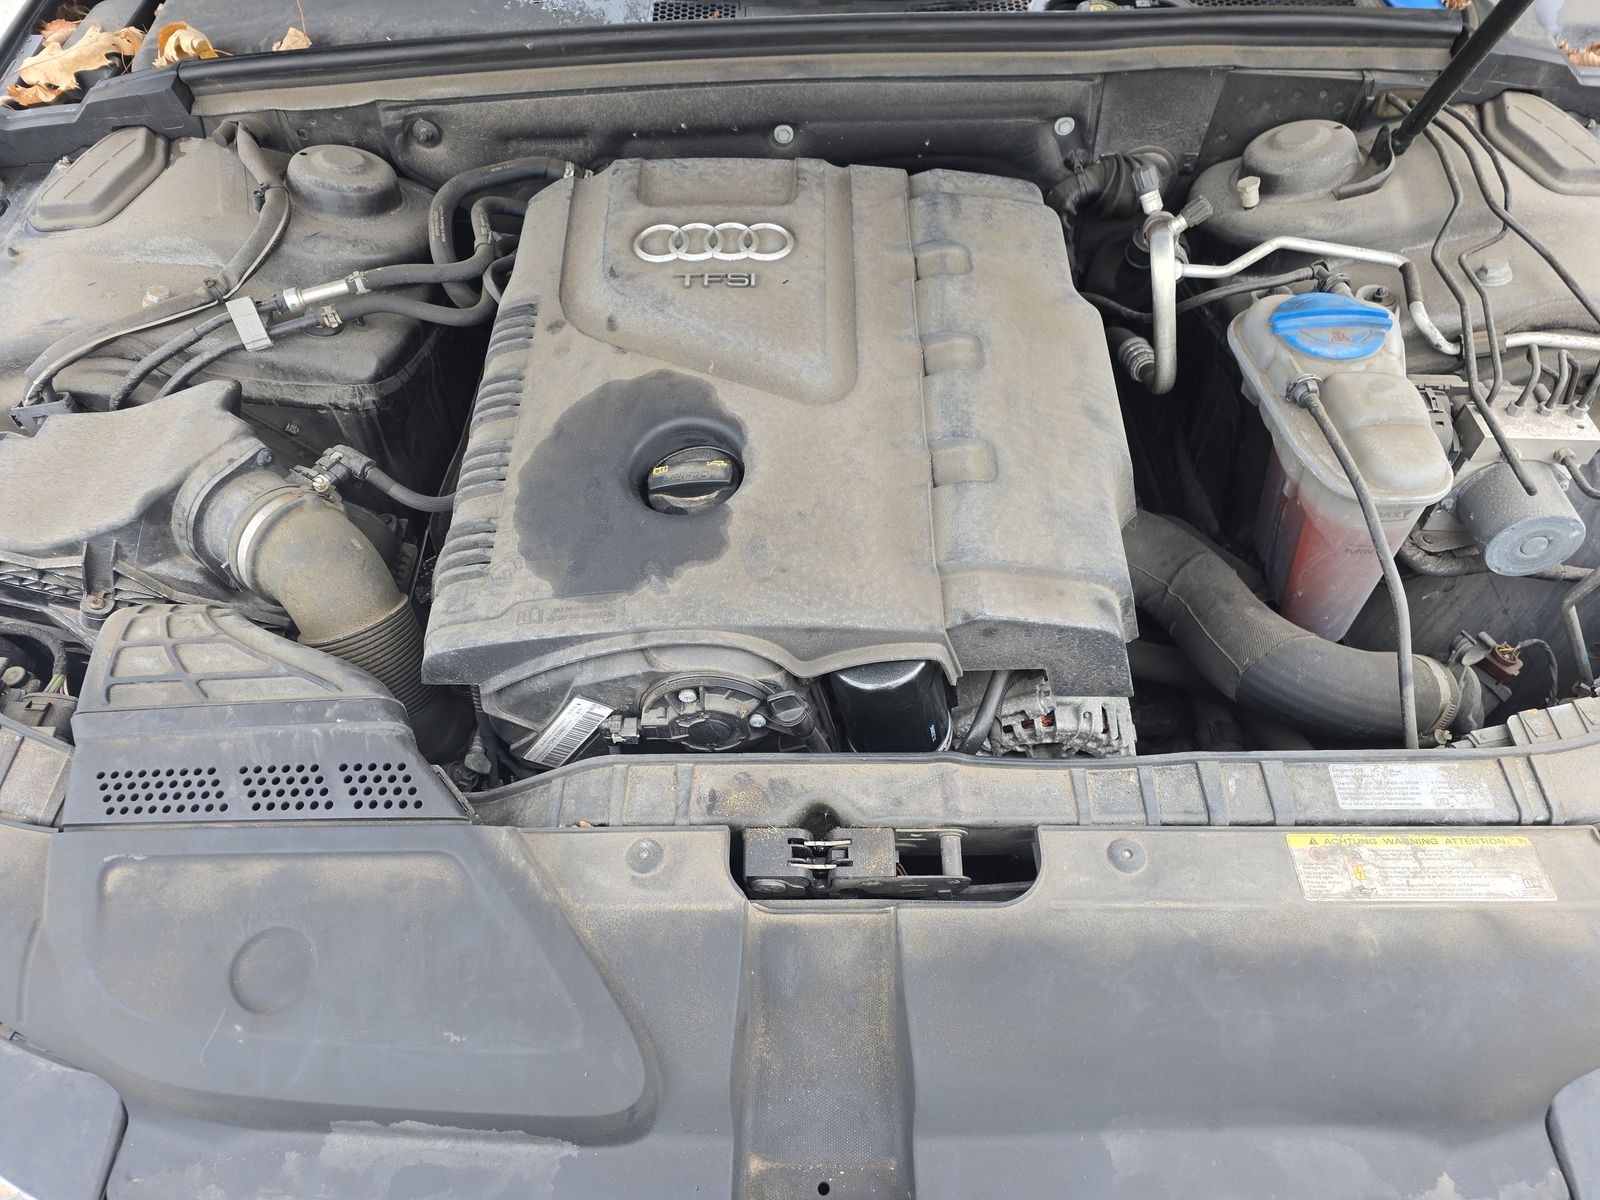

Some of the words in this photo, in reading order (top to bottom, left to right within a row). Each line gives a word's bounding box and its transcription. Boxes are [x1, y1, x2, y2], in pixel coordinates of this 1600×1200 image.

[673, 272, 757, 288] TFSI
[1324, 838, 1378, 846] ACHTUNG
[1445, 837, 1506, 846] ATTENTION
